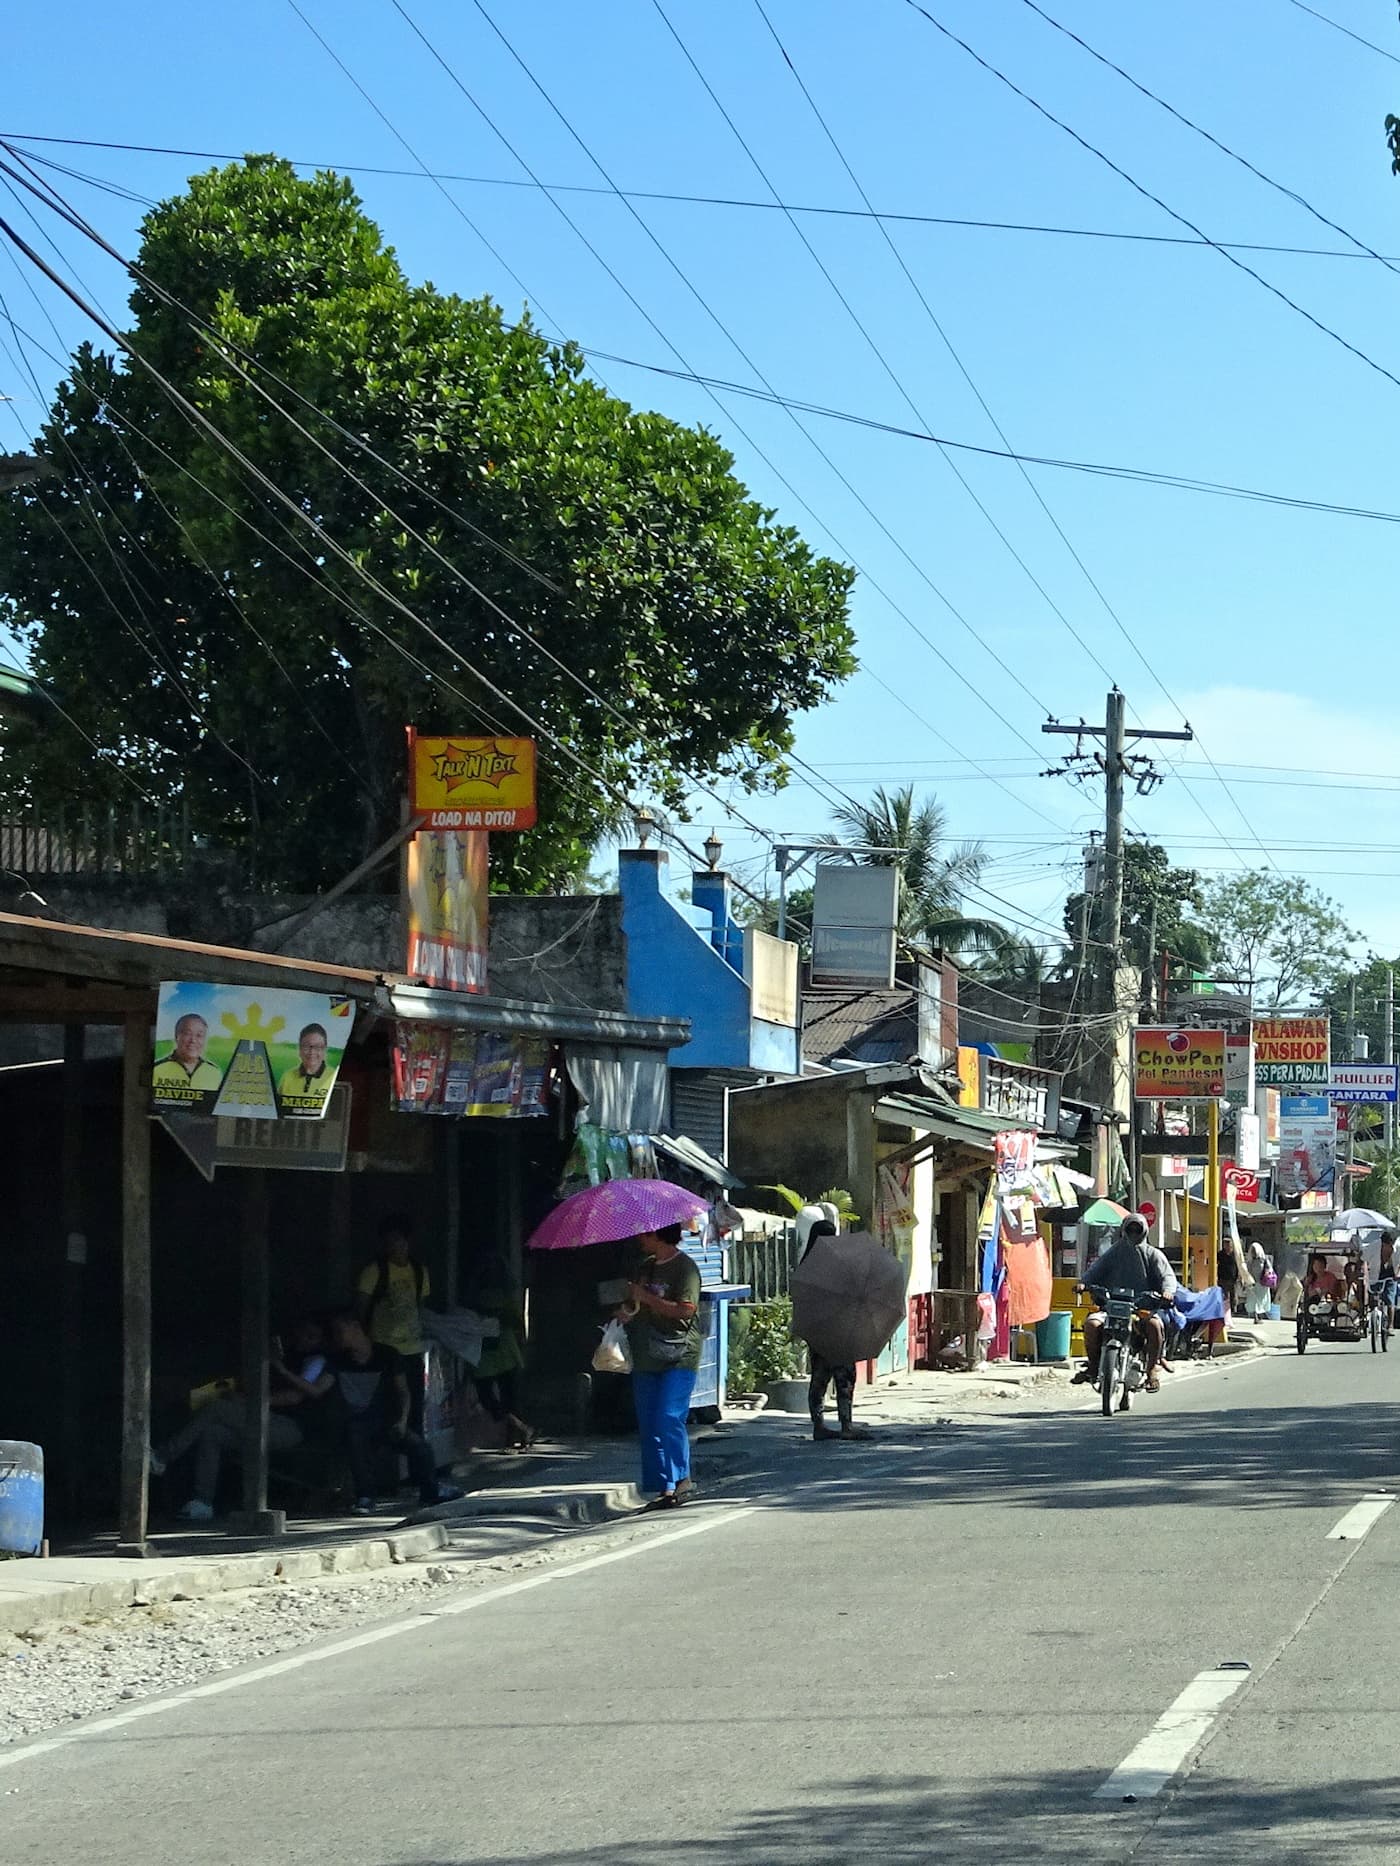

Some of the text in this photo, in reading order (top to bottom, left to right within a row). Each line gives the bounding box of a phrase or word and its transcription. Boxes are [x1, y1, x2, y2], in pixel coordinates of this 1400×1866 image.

[431, 811, 516, 826] LOAD NA DITO!
[1137, 1050, 1224, 1066] ChowPan
[1270, 1064, 1293, 1081] PERA
[1296, 1064, 1328, 1081] PADALA
[1331, 1074, 1393, 1085] HUILLIER
[157, 1077, 191, 1087] JUNJUN
[154, 1089, 204, 1100] DAVIDE
[235, 1118, 325, 1151] REMIT
